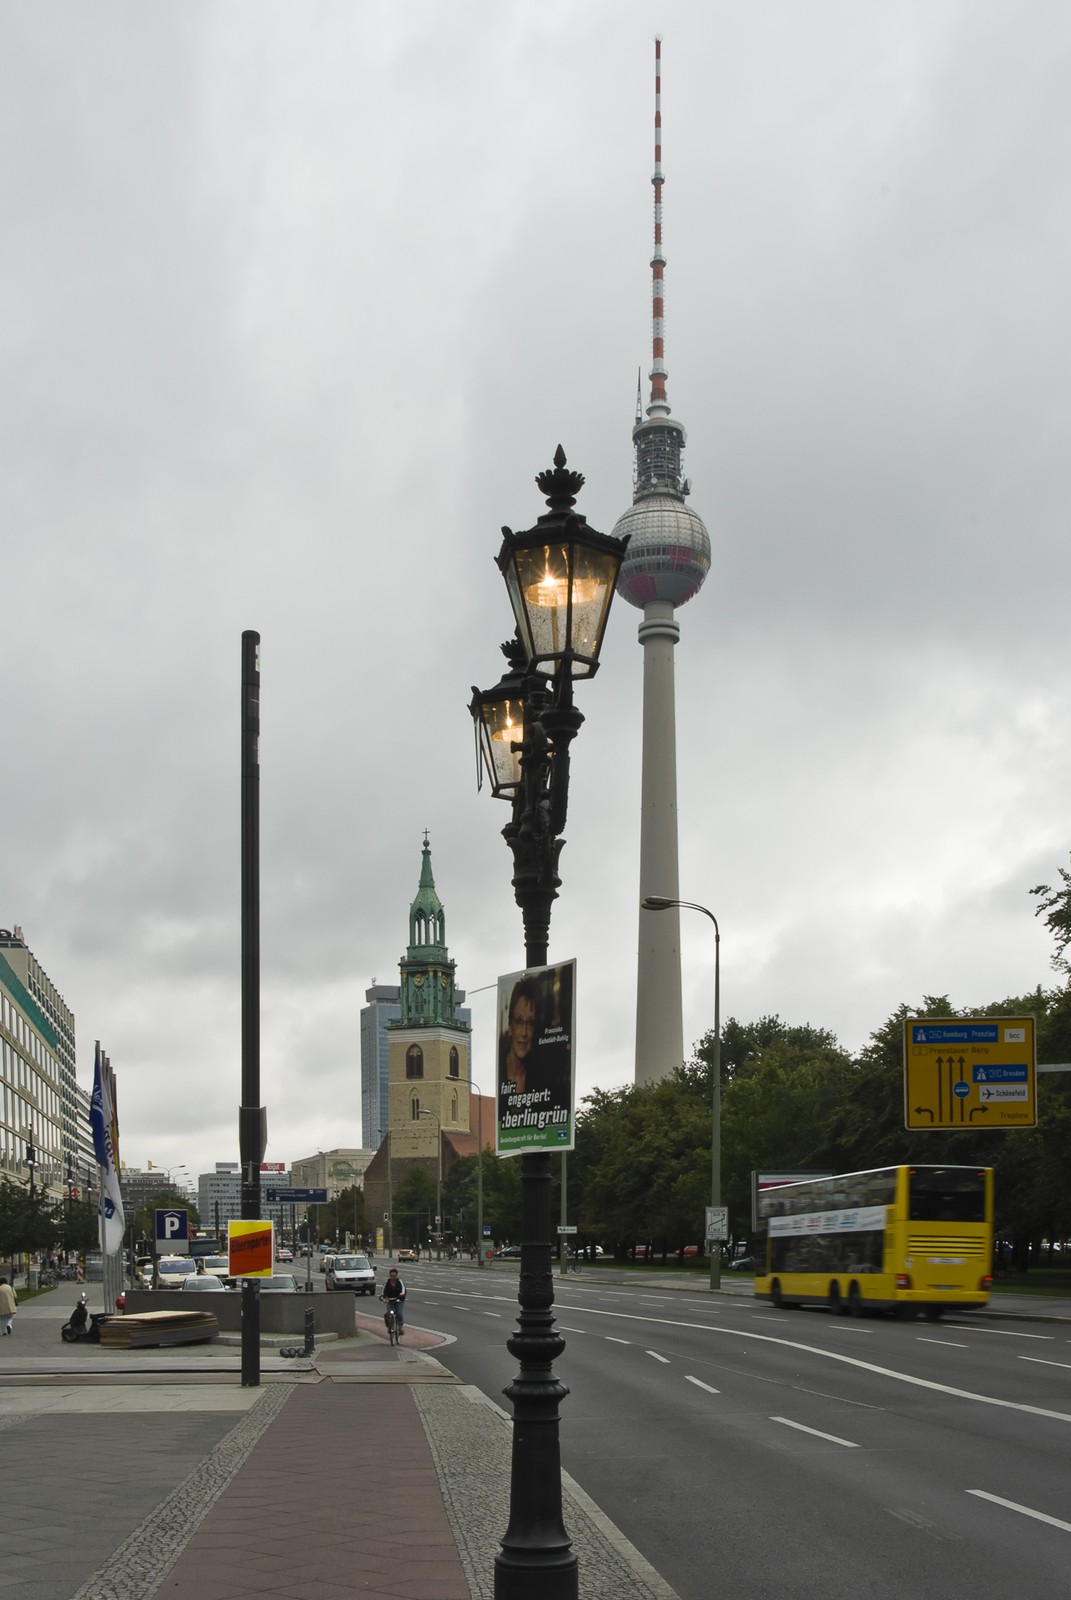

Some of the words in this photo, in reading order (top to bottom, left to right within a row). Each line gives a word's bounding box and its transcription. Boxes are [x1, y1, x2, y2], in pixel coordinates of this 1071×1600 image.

[943, 1030, 967, 1039] Hamburg
[971, 1046, 989, 1055] Berg
[1002, 1069, 1025, 1077] Dresden
[501, 1082, 516, 1095] fair:
[995, 1089, 1026, 1097] Schönefeld
[508, 1089, 551, 1107] engagiert:
[1000, 1111, 1029, 1120] Treptow
[165, 1217, 179, 1238] P
